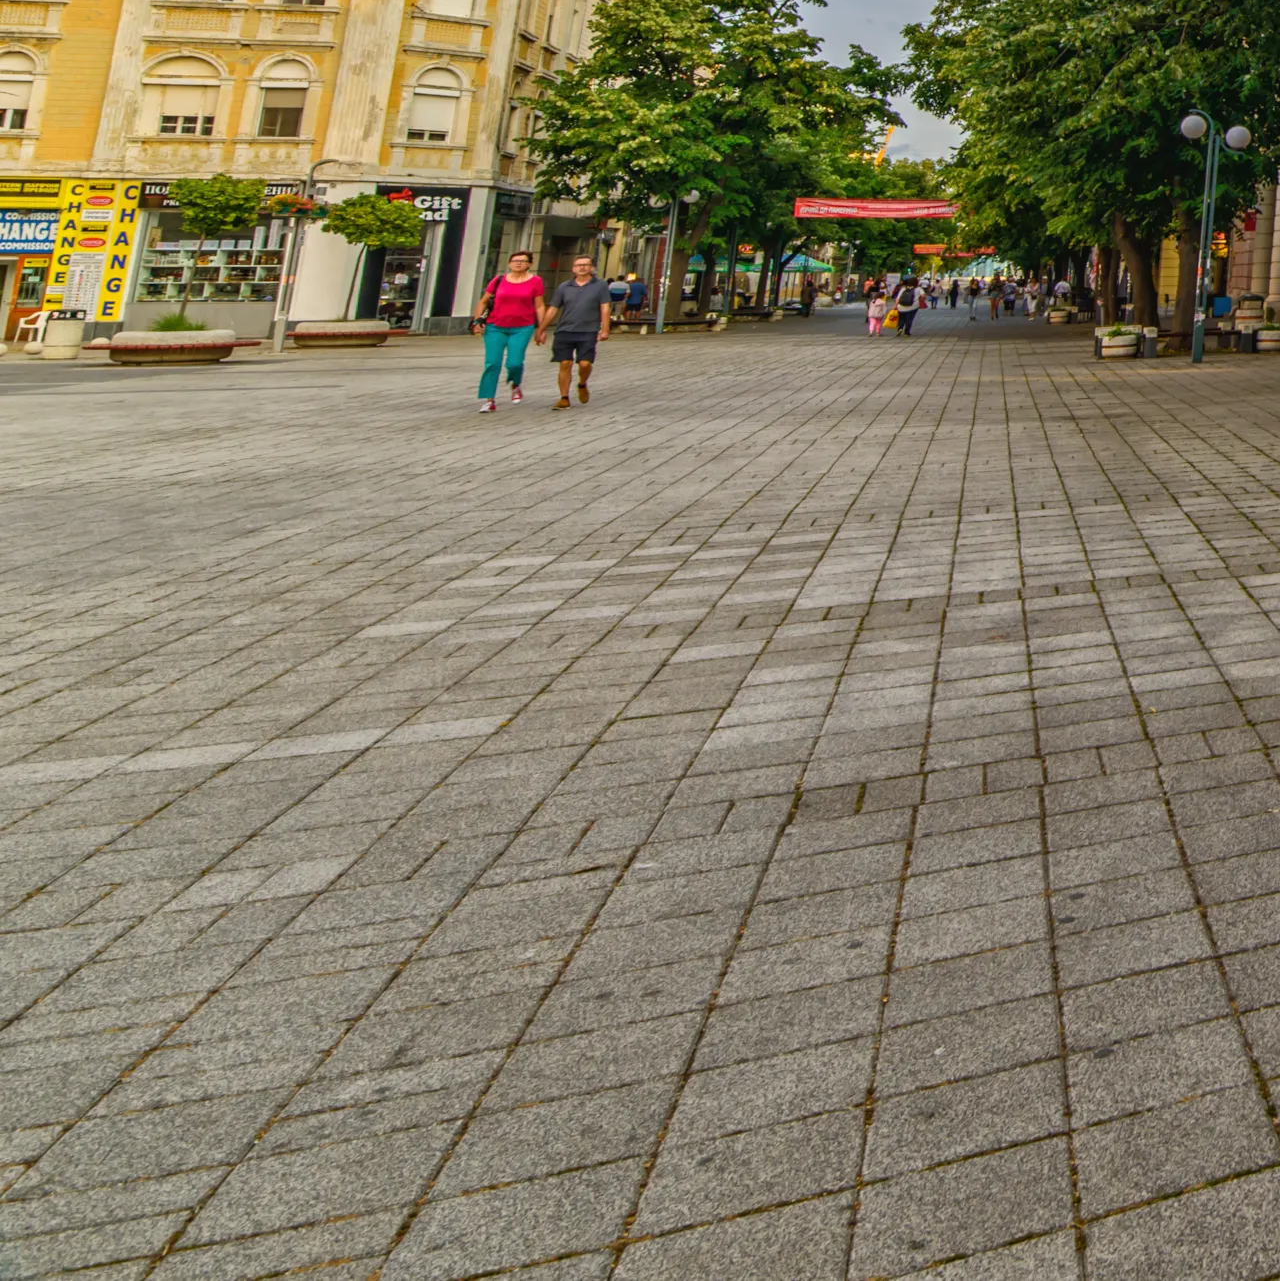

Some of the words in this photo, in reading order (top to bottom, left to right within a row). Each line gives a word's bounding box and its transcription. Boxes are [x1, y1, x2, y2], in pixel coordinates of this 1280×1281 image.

[55, 184, 84, 283] CHANGE
[101, 185, 138, 316] CHANGE
[414, 195, 462, 209] Gift
